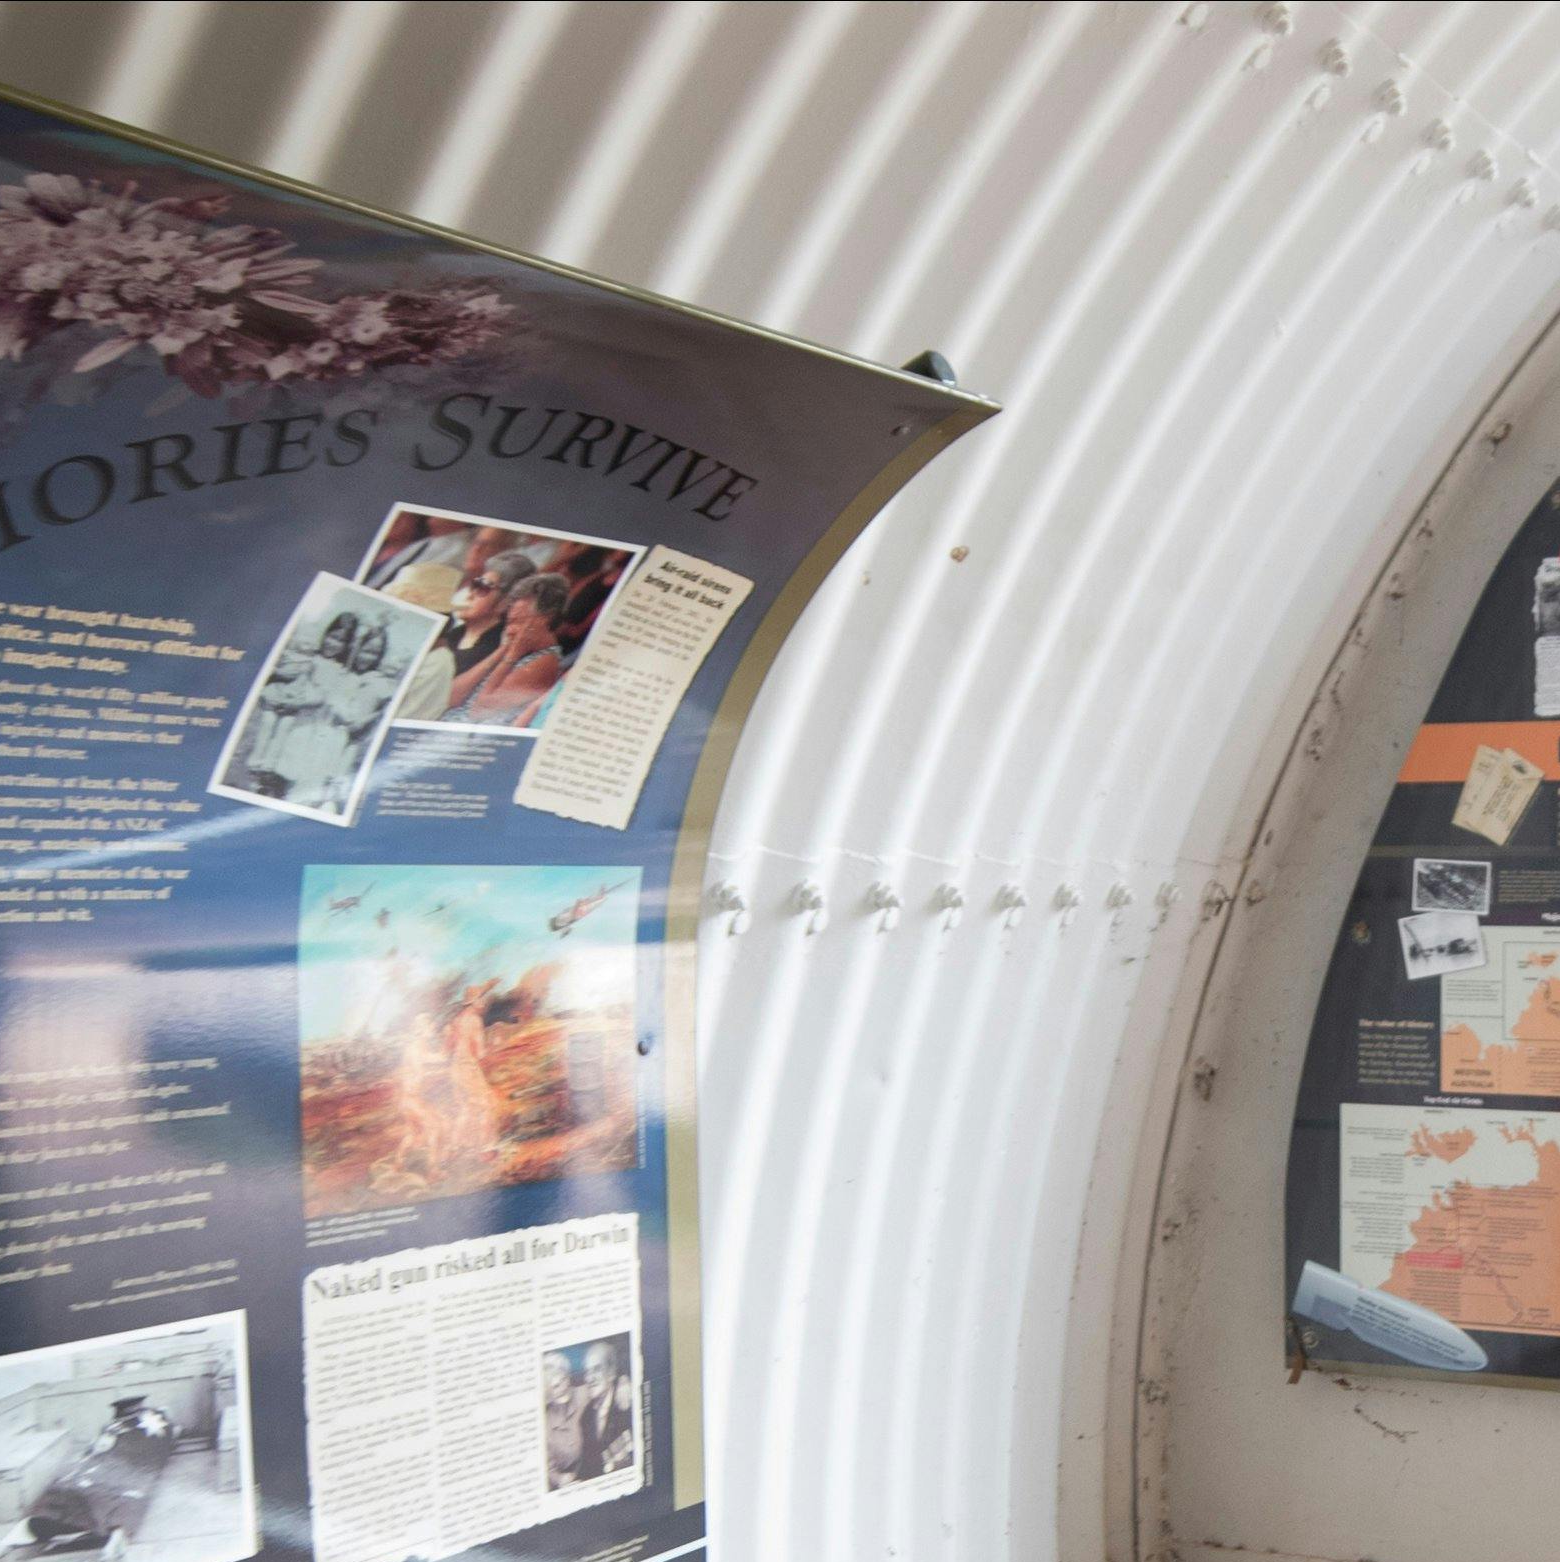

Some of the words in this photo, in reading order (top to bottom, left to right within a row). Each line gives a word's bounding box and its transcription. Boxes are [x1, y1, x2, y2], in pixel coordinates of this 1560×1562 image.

[414, 393, 758, 522] SURVIVE
[643, 573, 673, 593] bring
[672, 584, 683, 595] it
[682, 589, 699, 600] all
[698, 593, 726, 610] back
[660, 561, 700, 582] Air-raid
[700, 577, 733, 594] sirens
[8, 604, 43, 618] war
[44, 606, 118, 628] brought
[119, 614, 196, 636] hardship,
[1, 648, 76, 670] imagine
[77, 656, 130, 676] today.
[310, 1268, 381, 1303] Naked
[388, 1265, 427, 1293] gun
[434, 1247, 496, 1278] risked
[503, 1241, 525, 1265] all
[531, 1238, 557, 1260] for
[564, 1225, 629, 1253] Darwin
